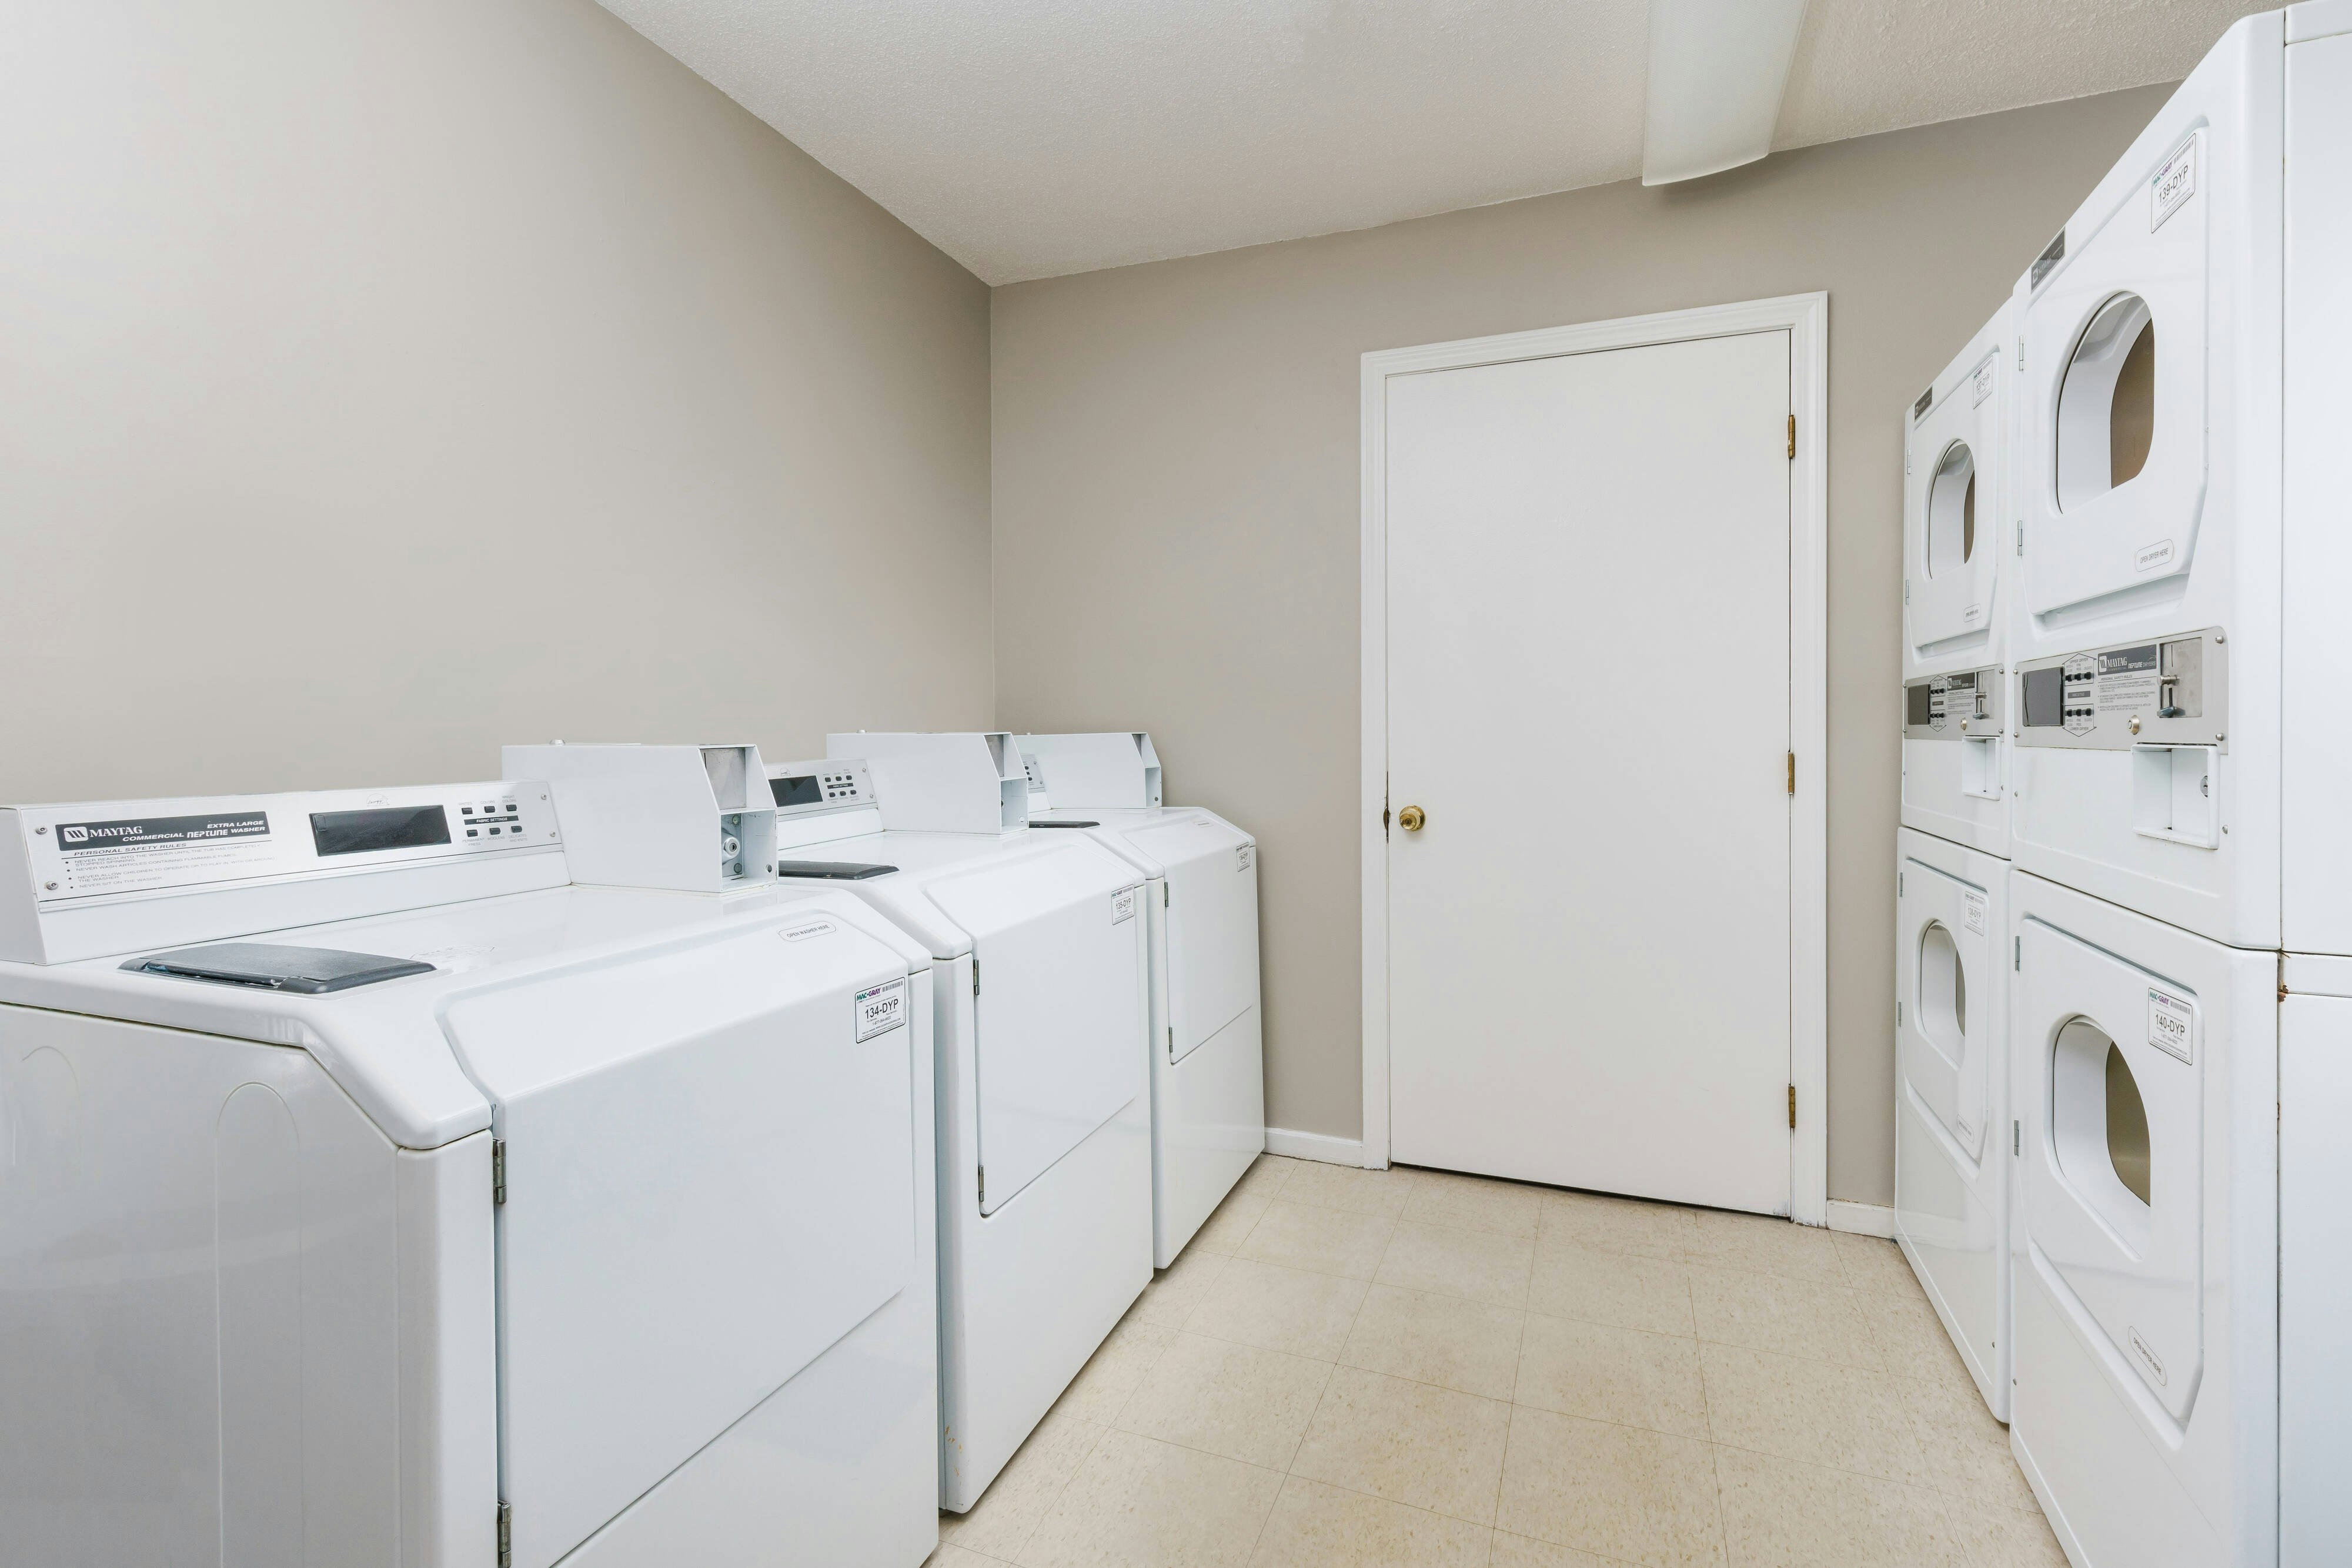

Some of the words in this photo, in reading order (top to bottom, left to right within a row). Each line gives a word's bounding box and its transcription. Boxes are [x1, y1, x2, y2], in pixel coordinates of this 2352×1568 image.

[2159, 165, 2189, 203] 139-DYP
[2107, 657, 2127, 668] MAYTAG
[89, 826, 143, 838] MAYTAG
[122, 833, 184, 842] COMMERCIAL
[187, 829, 228, 838] NEPTUNE
[1116, 898, 1131, 910] 135-DYP
[865, 999, 898, 1019] 134-DYP
[2156, 1014, 2185, 1037] 140-DYP
[2133, 1337, 2141, 1350] OPEN
[2153, 1360, 2161, 1375] HERE
